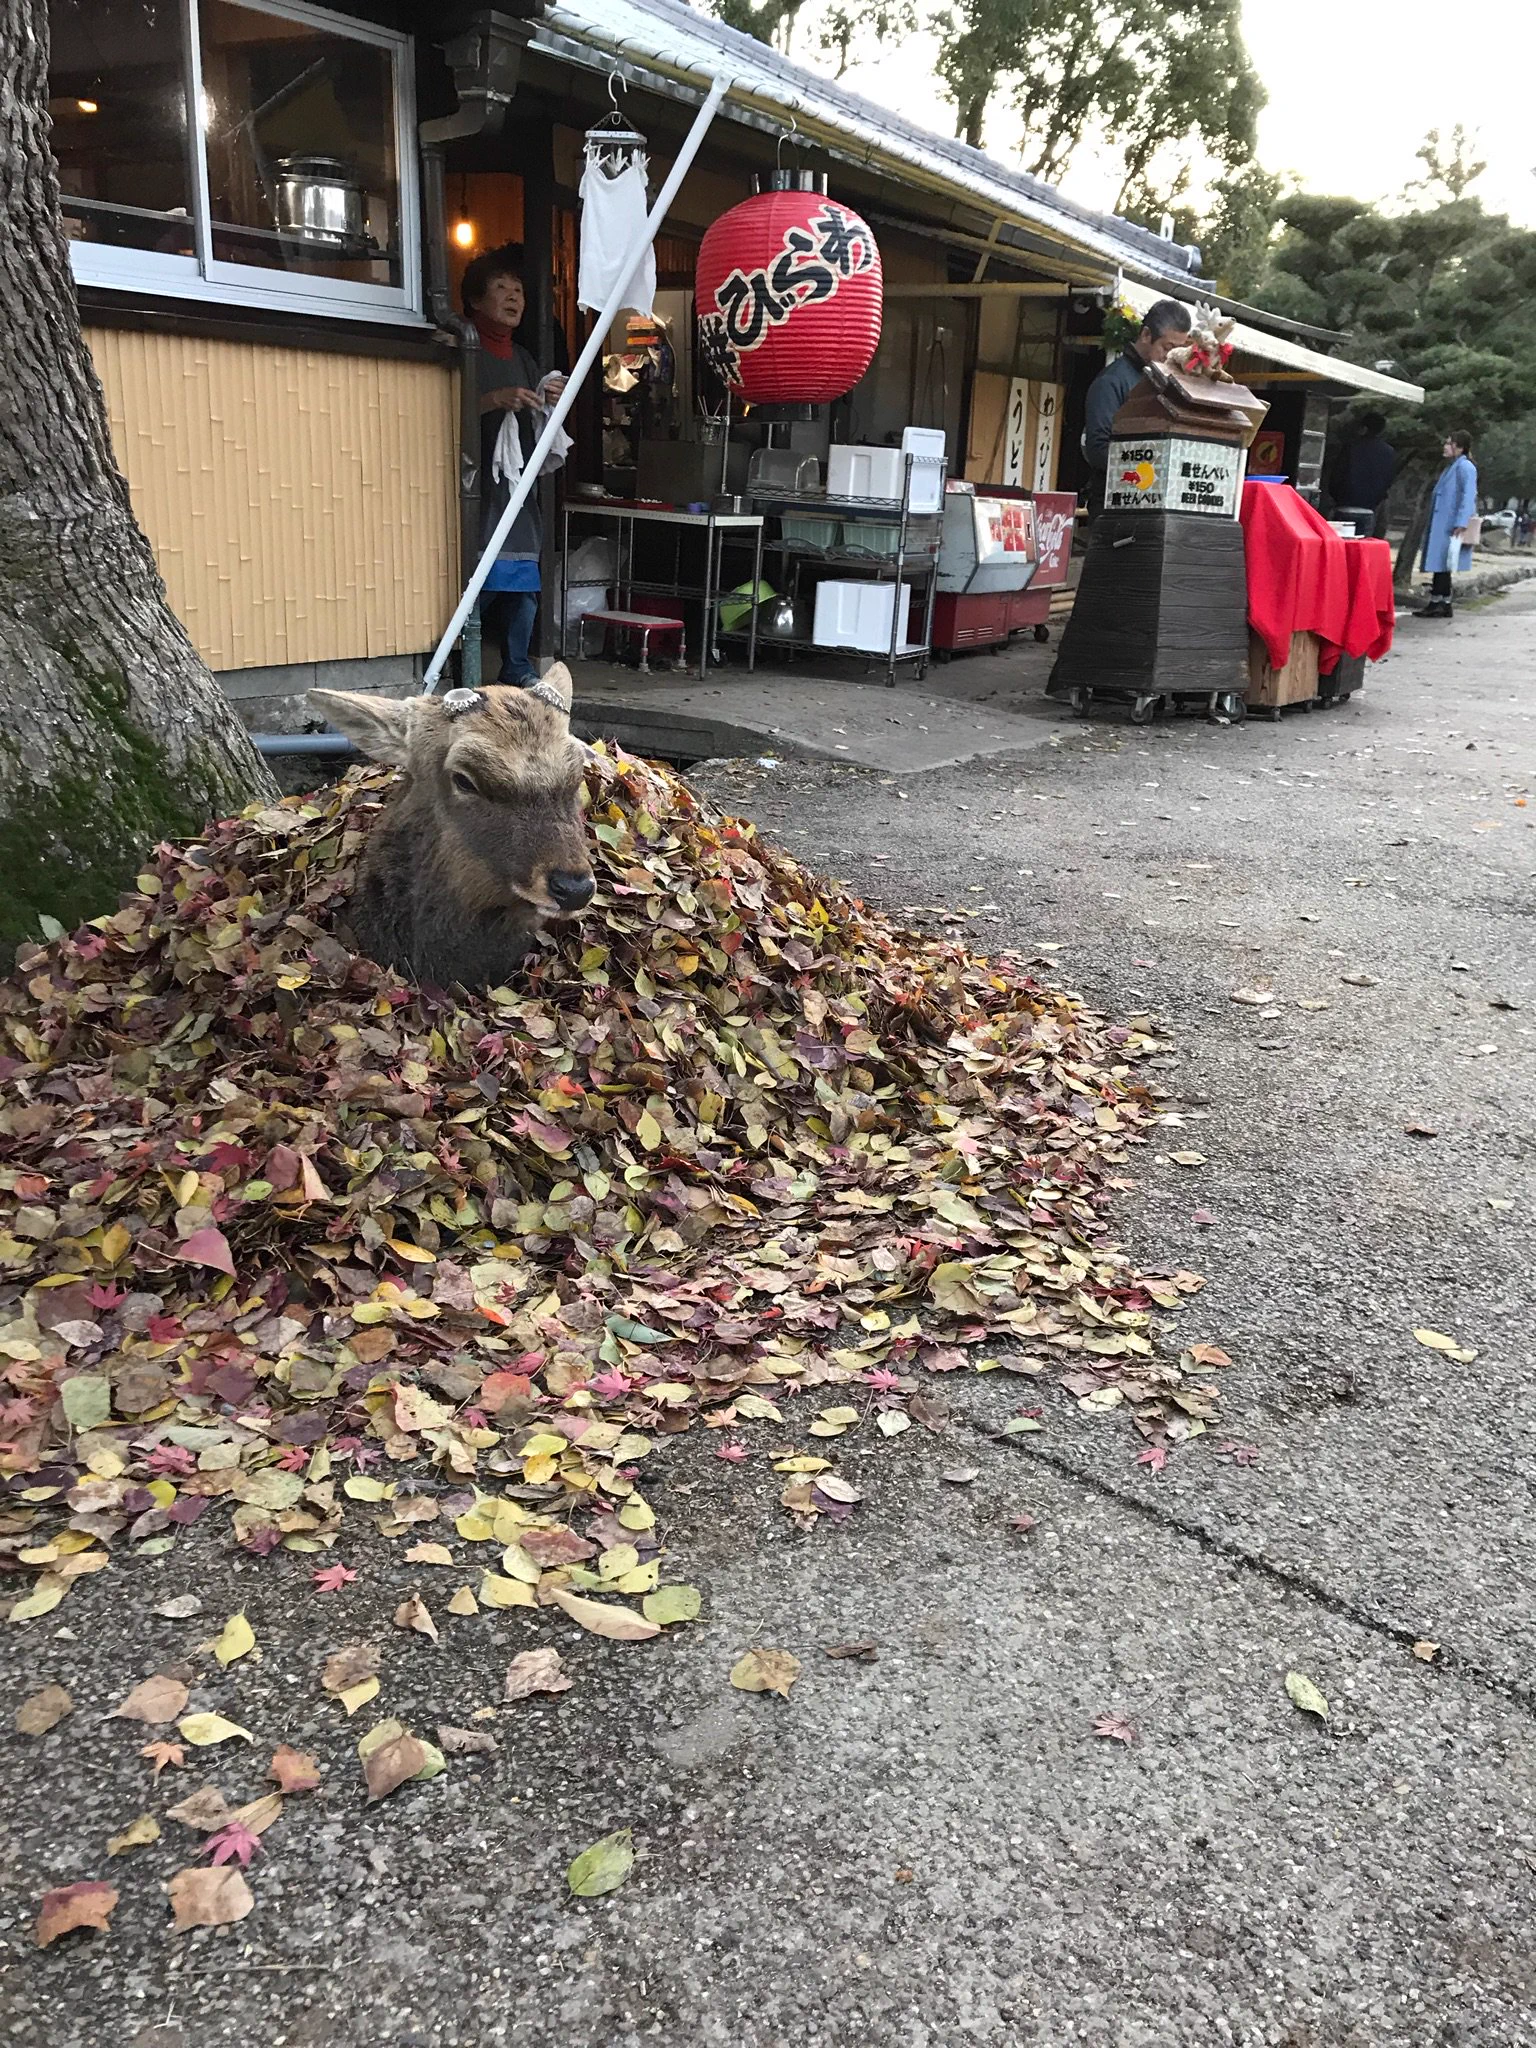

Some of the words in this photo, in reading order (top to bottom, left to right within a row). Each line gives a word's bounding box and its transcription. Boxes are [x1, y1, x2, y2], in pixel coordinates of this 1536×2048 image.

[1011, 388, 1022, 486] うど
[1121, 449, 1153, 461] ¥150
[1181, 462, 1230, 480] 鹿せんべい
[1188, 481, 1214, 493] ¥150
[1111, 492, 1162, 506] 鹿せんべい
